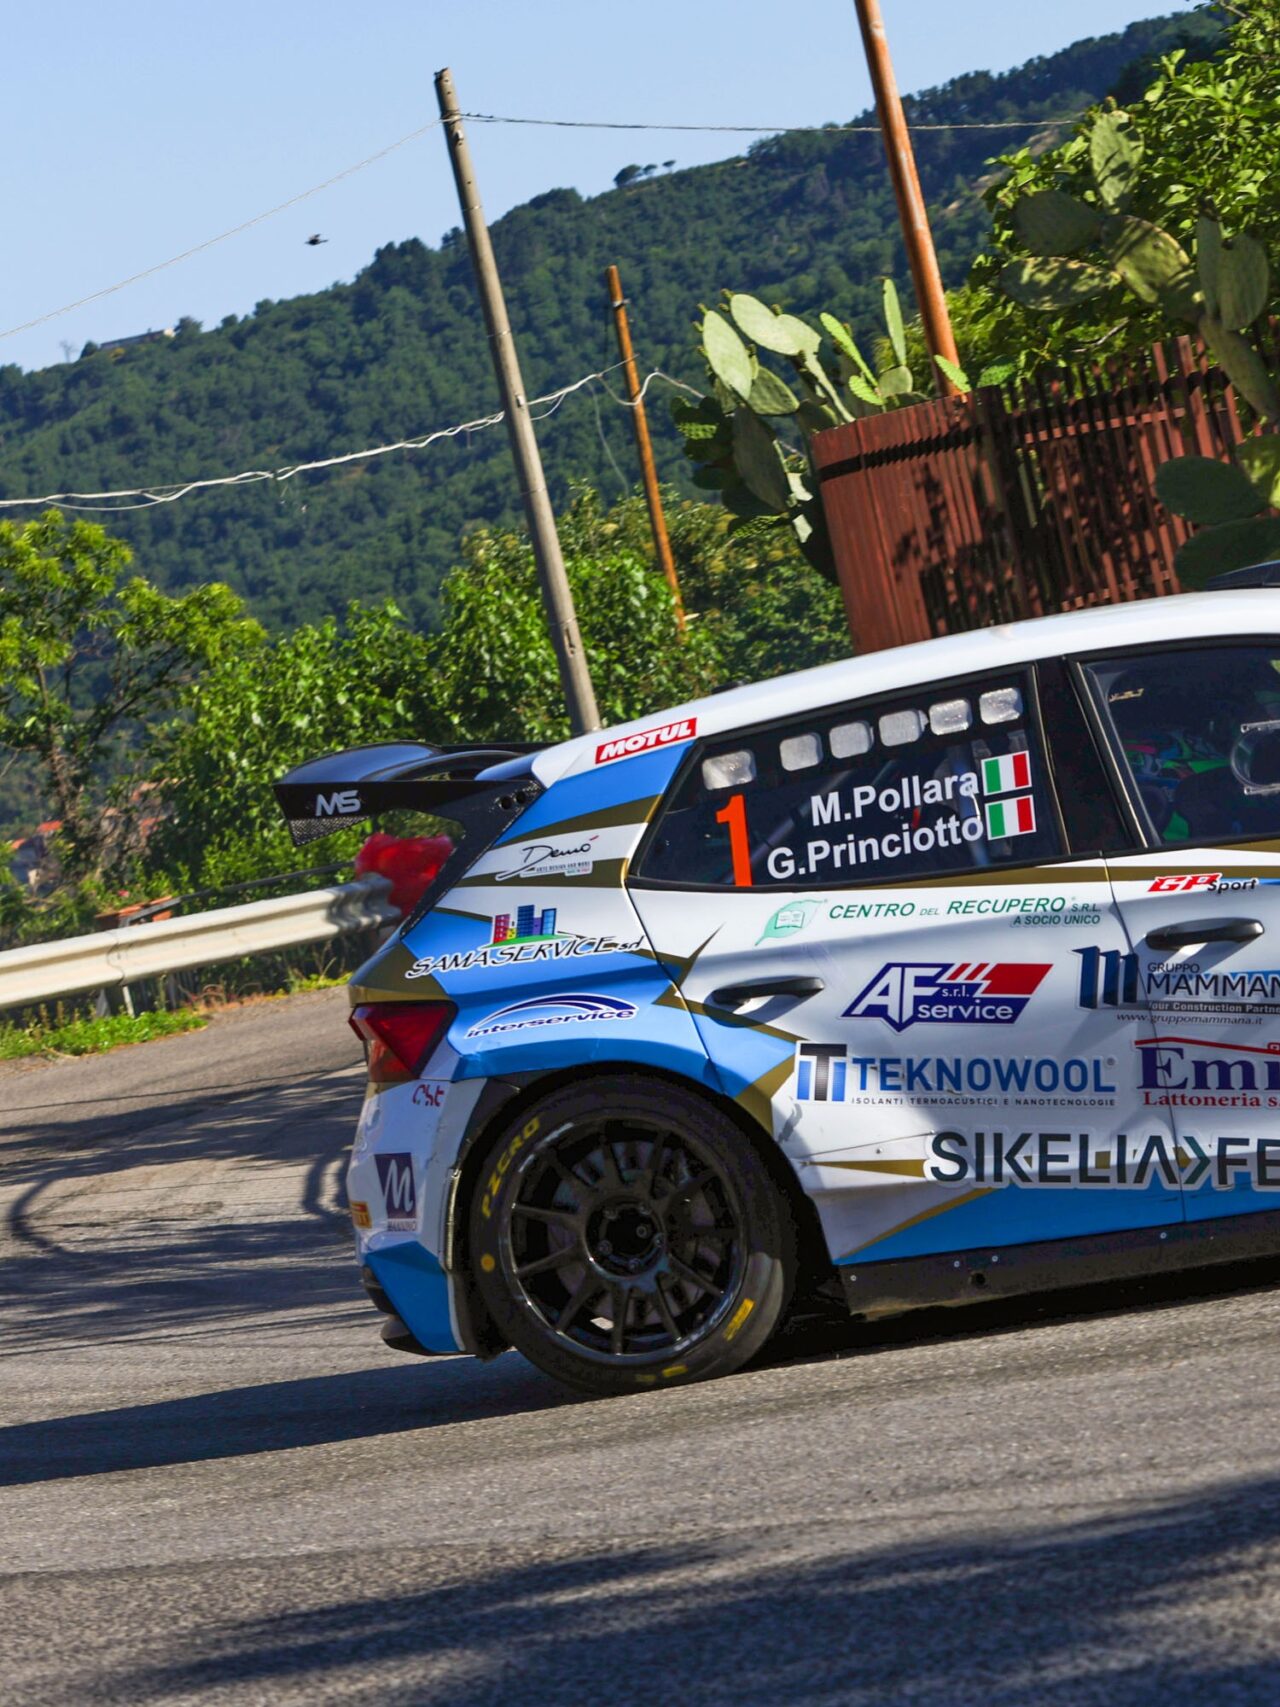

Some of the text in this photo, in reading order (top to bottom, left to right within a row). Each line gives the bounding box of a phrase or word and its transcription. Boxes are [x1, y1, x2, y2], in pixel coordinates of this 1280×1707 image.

[601, 720, 693, 760] MOTUL
[316, 789, 361, 817] MS
[811, 772, 979, 826] M.Pollara
[715, 794, 753, 886] 1
[767, 816, 983, 880] G.Princiotto
[1147, 873, 1257, 894] GP Sport
[828, 902, 916, 920] CENTRO
[919, 907, 940, 917] DEL
[946, 896, 1066, 916] RECUPERO
[1012, 913, 1101, 926] A SOCIO UNICO
[1147, 962, 1200, 974] GRUPPO
[851, 966, 944, 1024] AF
[942, 984, 970, 997] s.r.l.
[917, 999, 1013, 1020] service
[1116, 1013, 1263, 1025] www.gruppomammana.it
[1172, 1003, 1243, 1013] Construction
[467, 1009, 635, 1038] interservice
[852, 1057, 1116, 1093] TEKNOWOOL
[851, 1096, 1116, 1107] ISOLANTI TERMOACUSTICI E NANOTECNOLOGIE
[1143, 1091, 1261, 1107] Lattoneria
